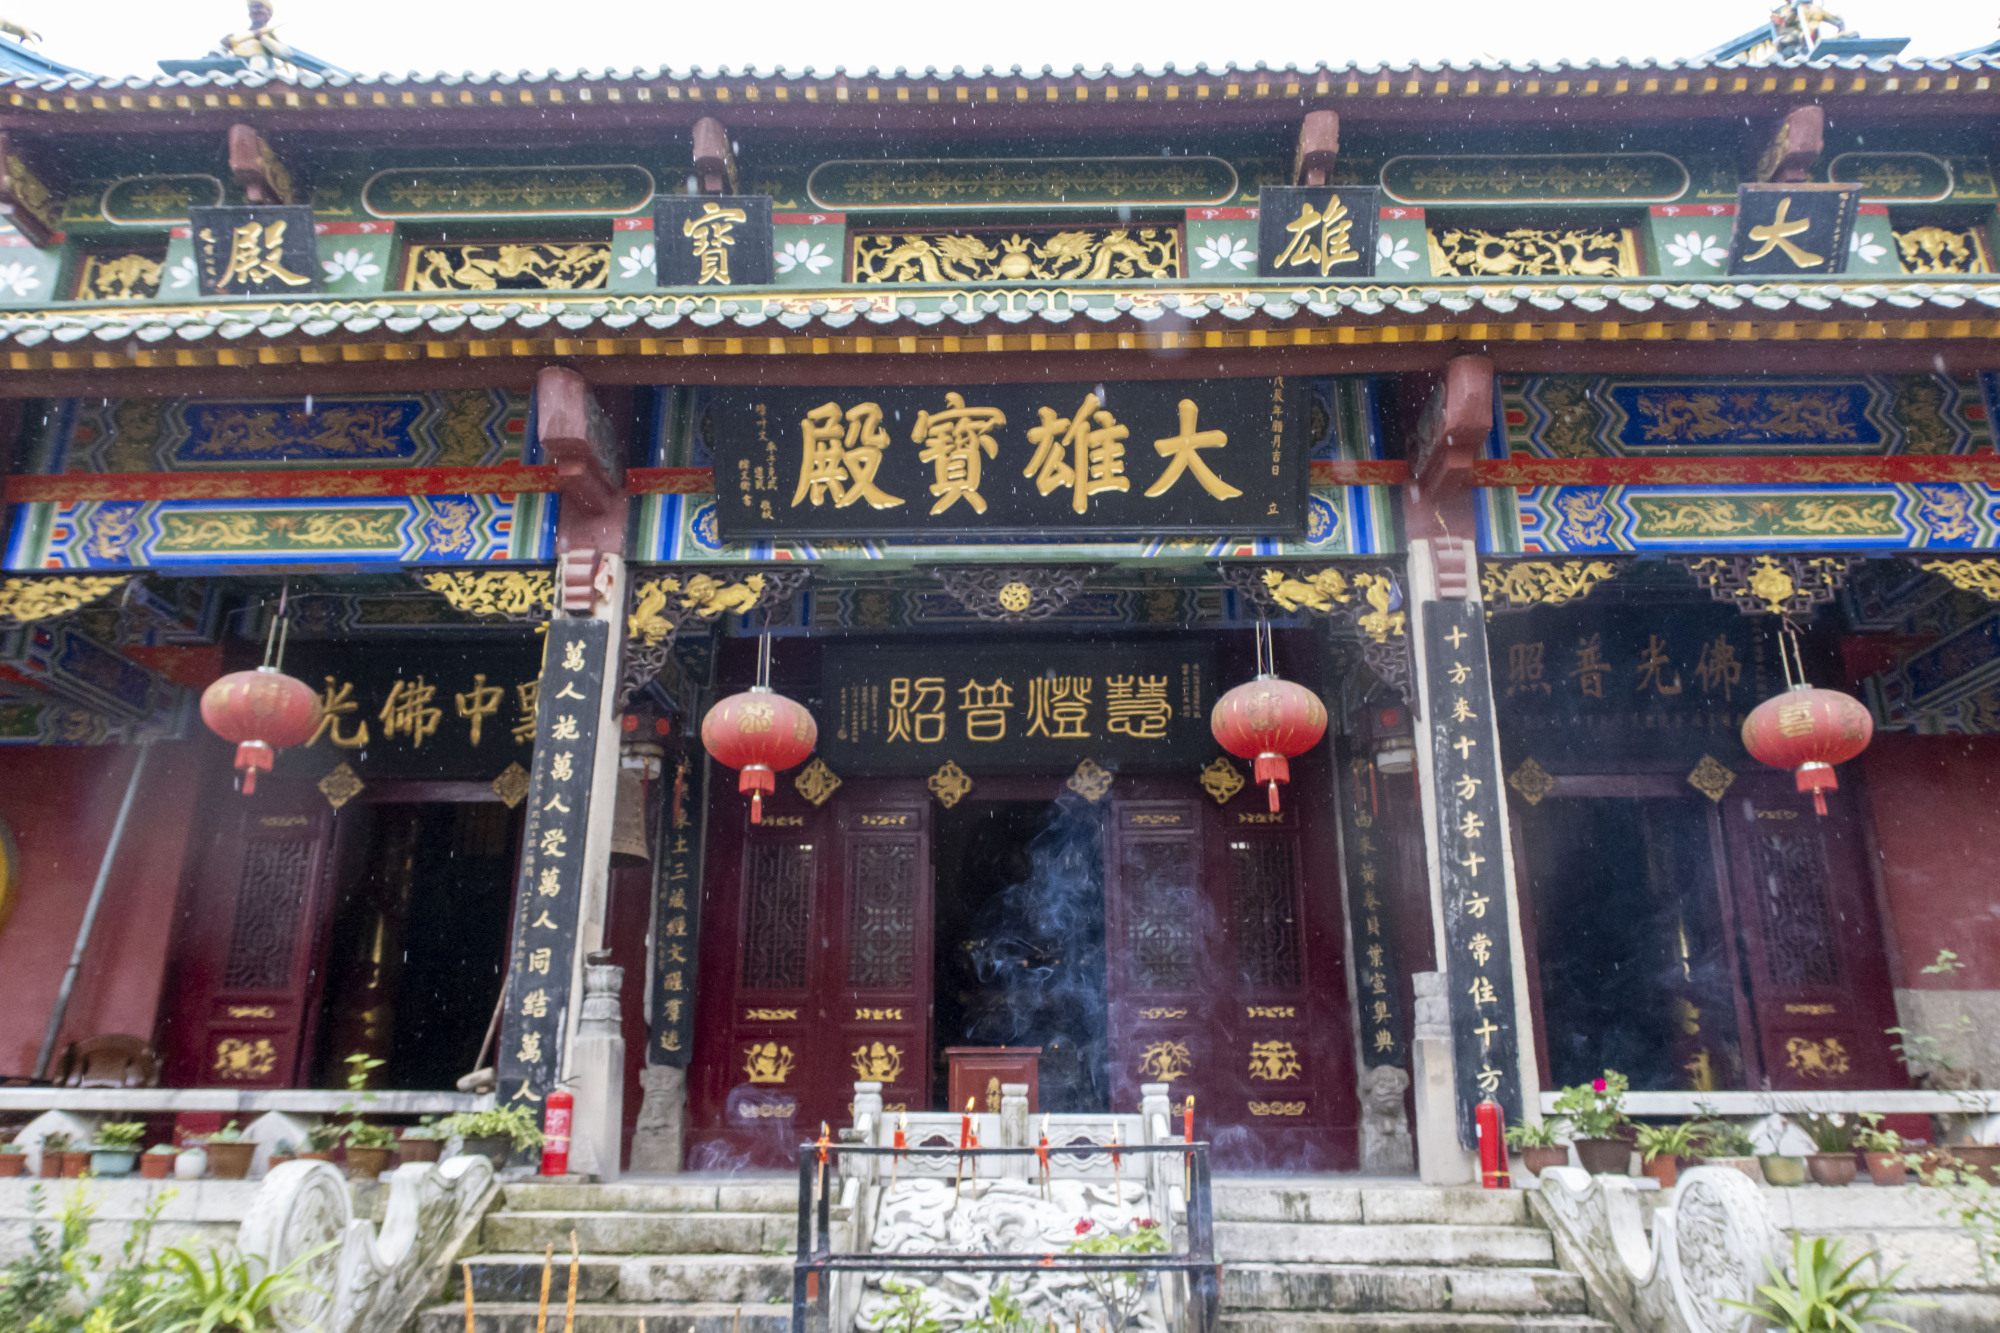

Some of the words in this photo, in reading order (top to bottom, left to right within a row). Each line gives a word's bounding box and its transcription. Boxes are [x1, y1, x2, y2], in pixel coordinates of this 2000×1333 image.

[217, 220, 311, 288] 殿
[1274, 194, 1359, 277] 雄
[1743, 197, 1824, 268] 大
[791, 391, 1243, 515] 大雄寶殿
[1505, 633, 1744, 702] 佛光普照
